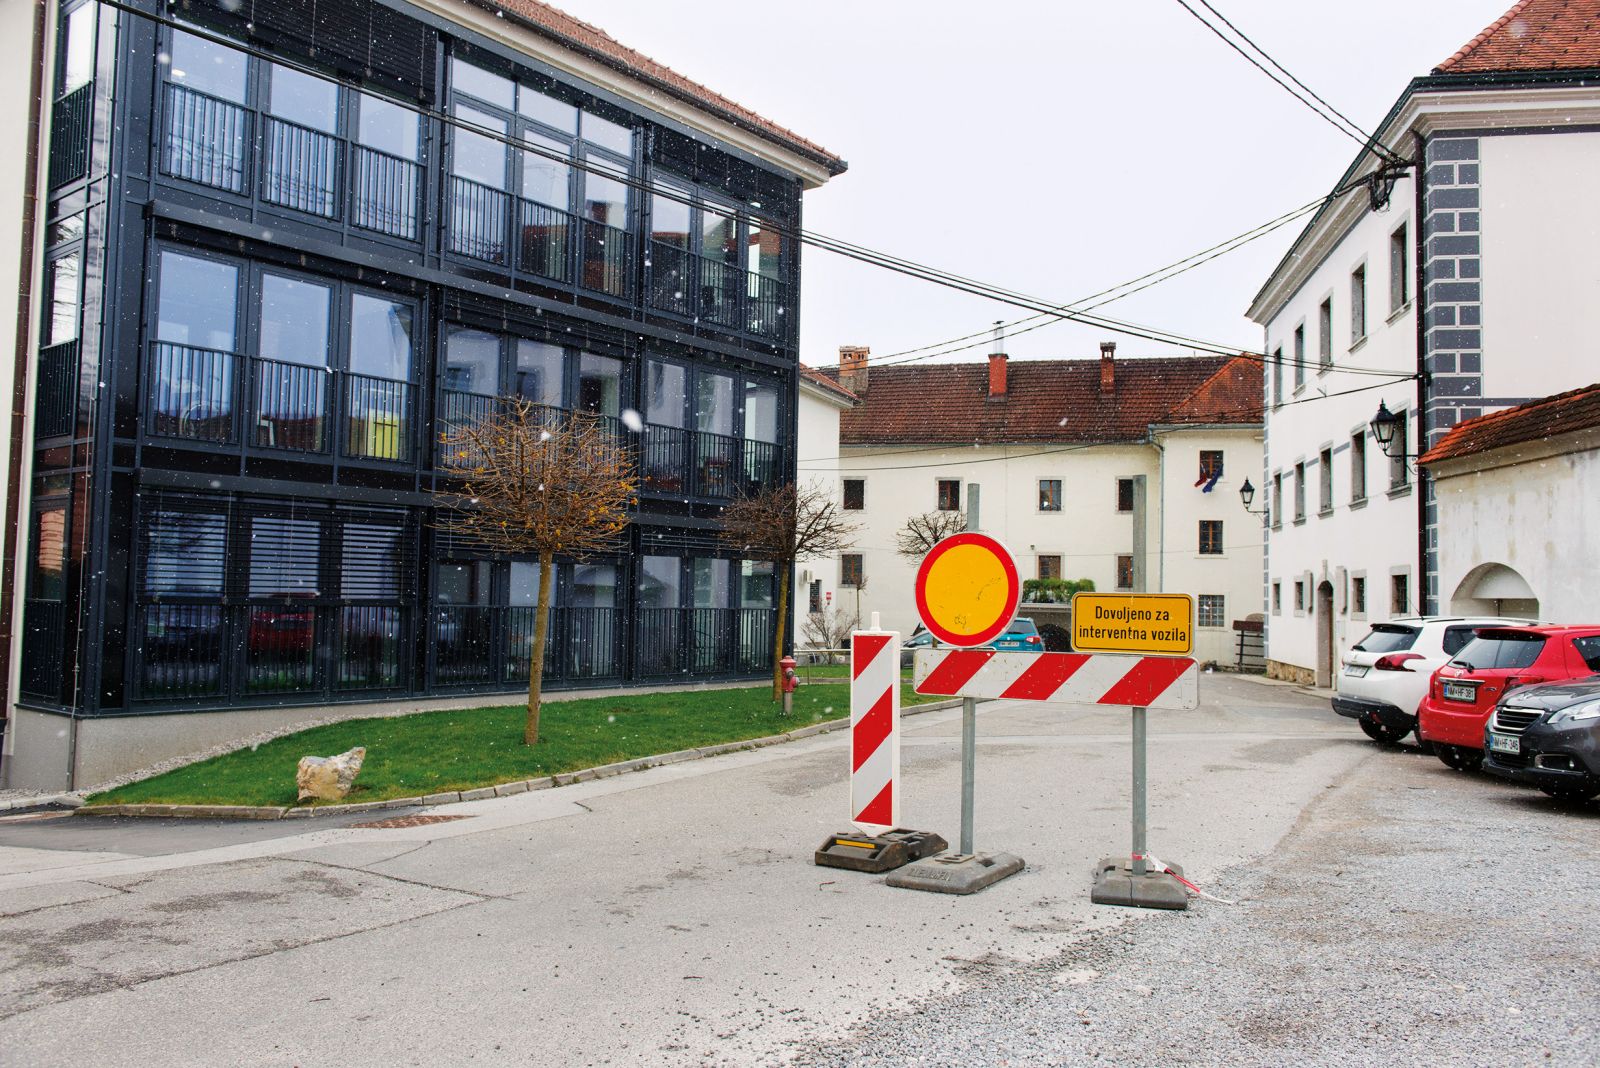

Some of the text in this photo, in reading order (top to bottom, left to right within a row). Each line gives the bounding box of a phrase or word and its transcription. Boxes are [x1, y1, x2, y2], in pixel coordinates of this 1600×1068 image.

[1095, 606, 1170, 623] Dovoljeno za
[1079, 625, 1186, 641] interventna vozila
